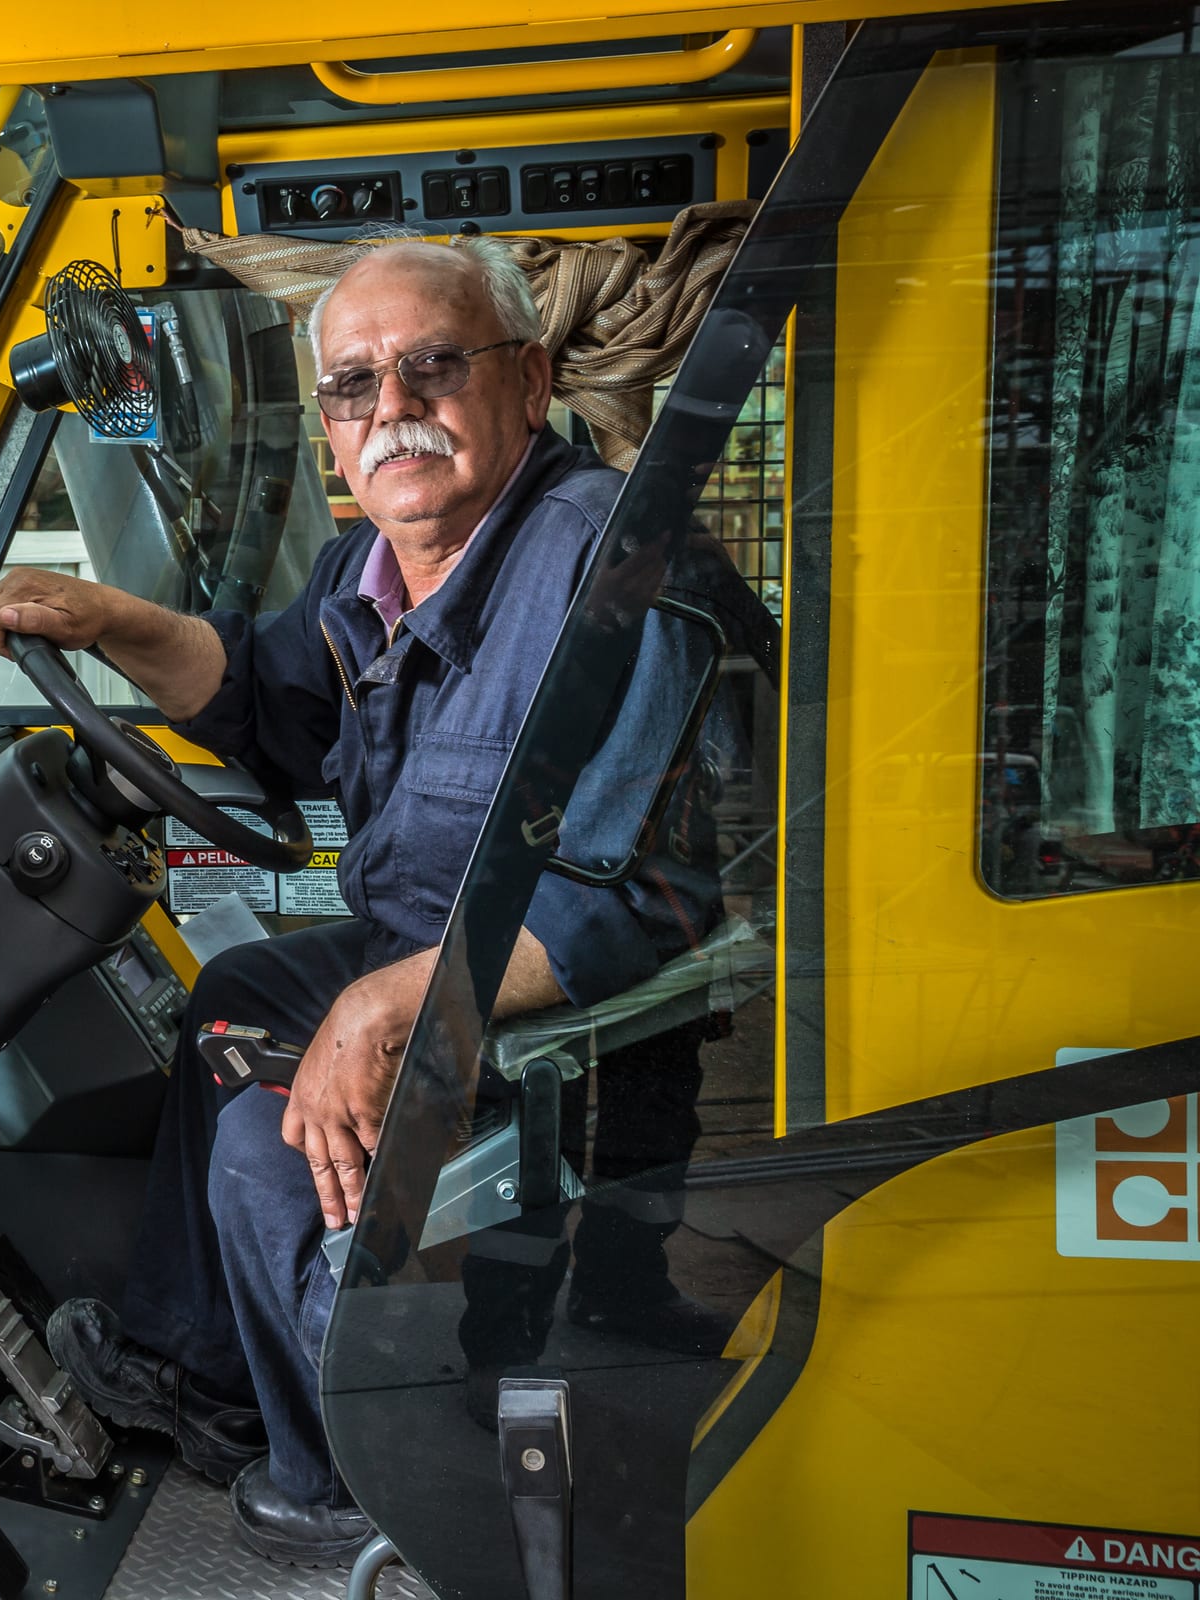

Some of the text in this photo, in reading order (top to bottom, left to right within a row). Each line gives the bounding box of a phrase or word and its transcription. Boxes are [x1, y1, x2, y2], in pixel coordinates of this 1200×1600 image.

[302, 804, 332, 812] TRAVEL
[1060, 1571, 1157, 1588] TIPPING HAZARD
